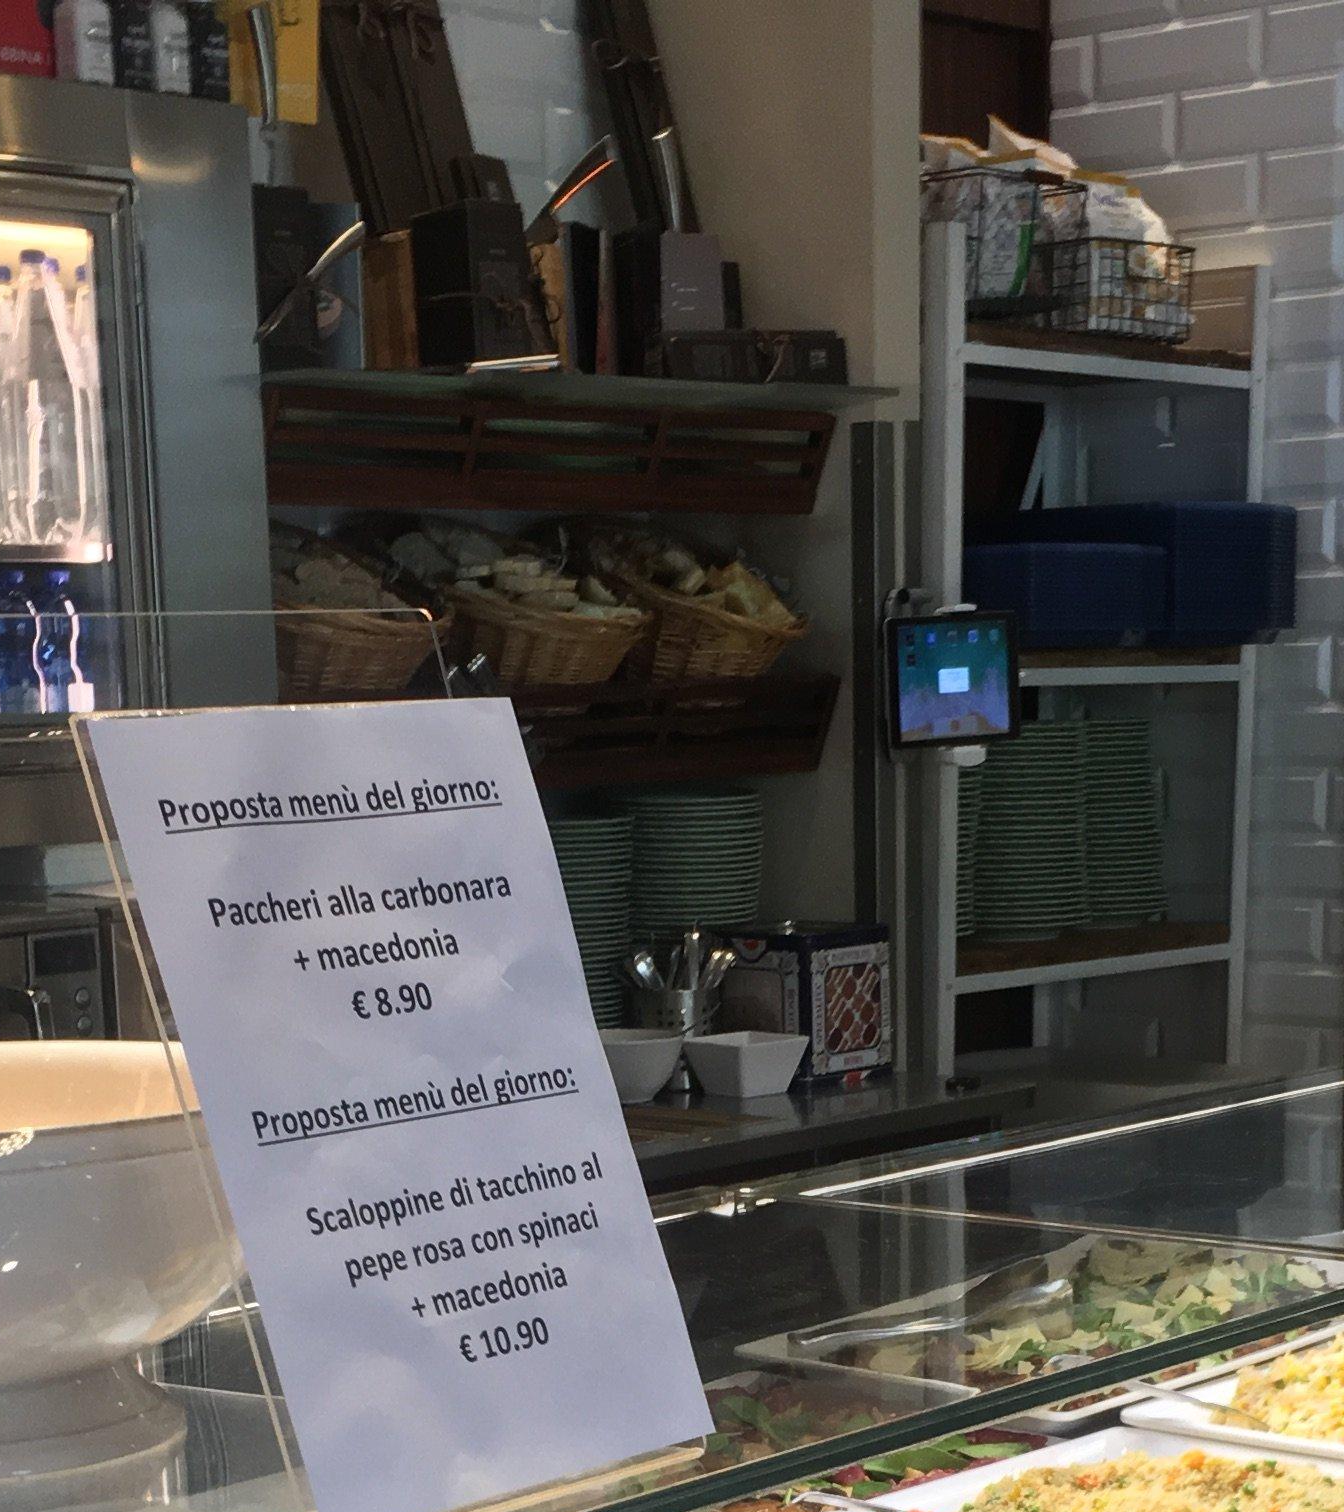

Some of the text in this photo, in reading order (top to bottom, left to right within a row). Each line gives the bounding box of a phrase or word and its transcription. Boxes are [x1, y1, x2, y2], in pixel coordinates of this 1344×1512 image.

[158, 779, 500, 828] Proposta menù del giorno:
[207, 875, 512, 928] Paccheri alla carbonara
[293, 928, 459, 971] + macedonia
[351, 982, 433, 1020] € 8.90
[251, 1067, 577, 1141] Proposta menù del giorno:
[306, 1151, 603, 1237] Scaloppine di tacchino al
[343, 1201, 600, 1289] pepe rosa con spinaci
[411, 1261, 568, 1318] + macedonia
[459, 1316, 549, 1364] € 10.90
